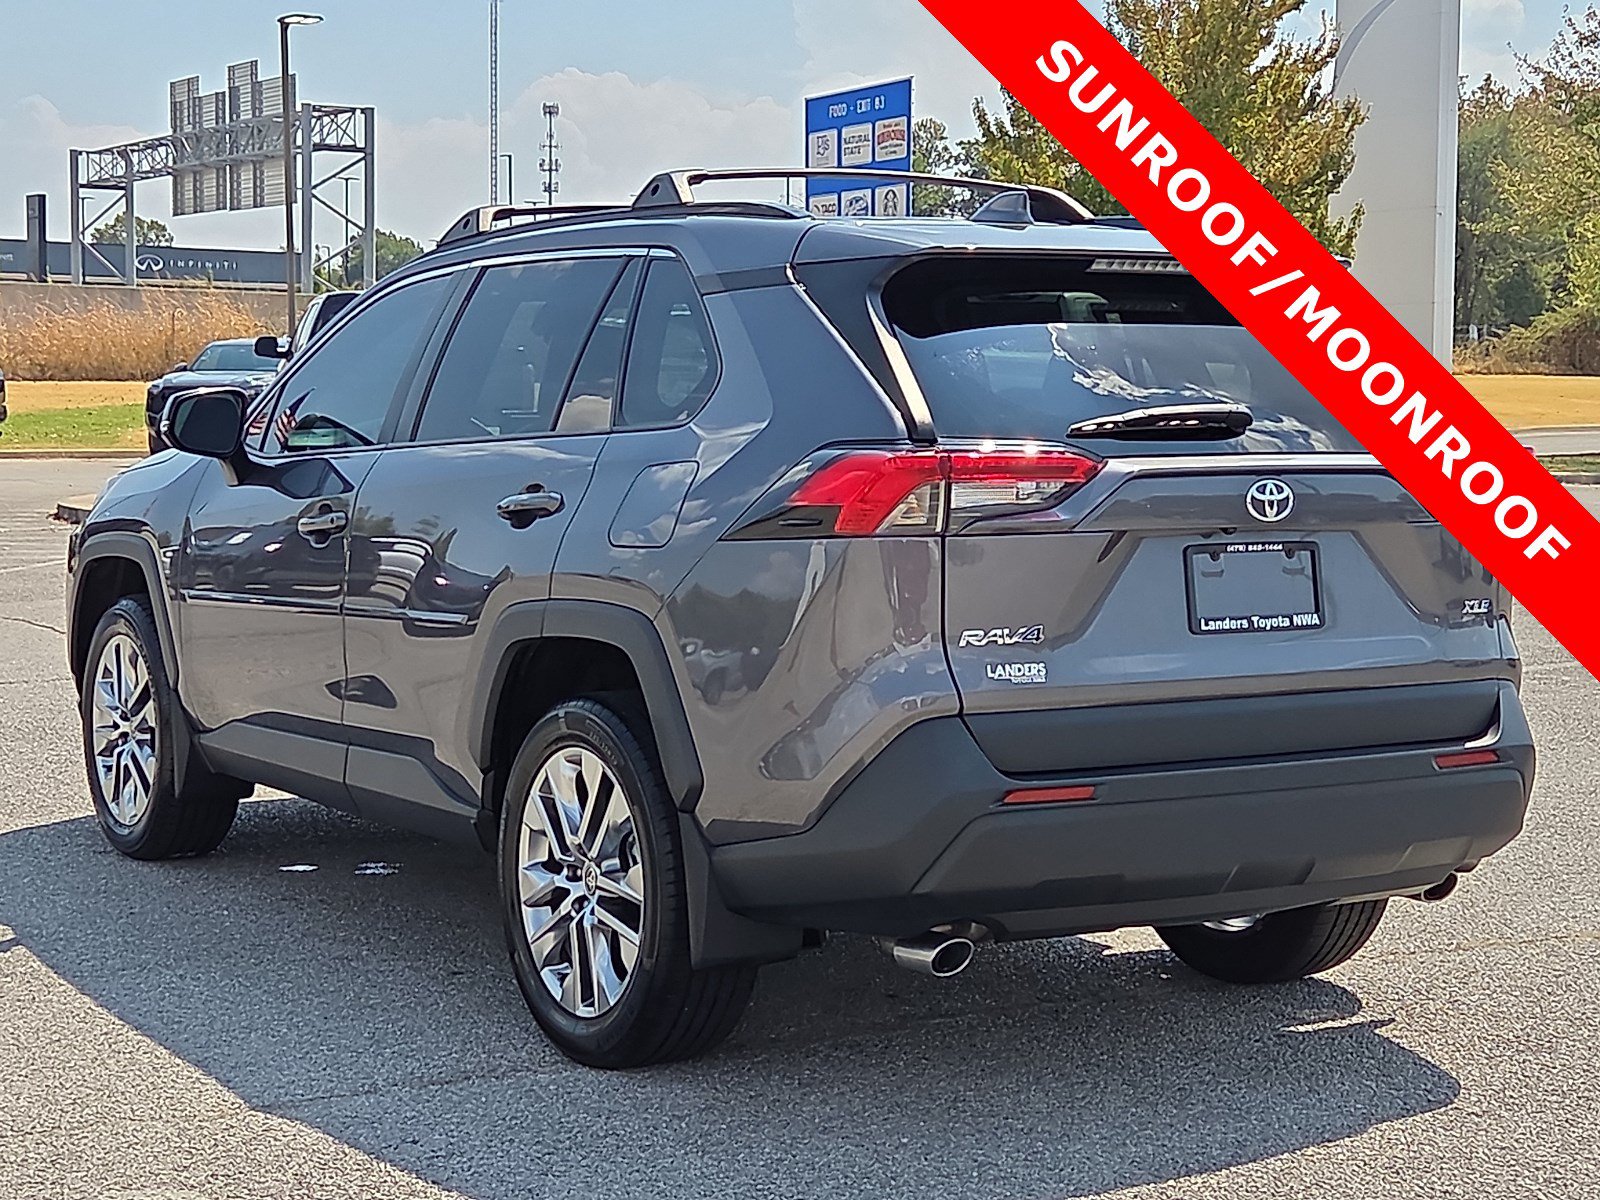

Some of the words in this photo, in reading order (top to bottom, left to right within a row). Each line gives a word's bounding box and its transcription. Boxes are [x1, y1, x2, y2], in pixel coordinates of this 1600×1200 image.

[828, 103, 848, 118] FOOD
[856, 98, 872, 114] EXIT
[843, 133, 871, 146] NATURAL
[843, 146, 862, 157] STATE
[169, 259, 238, 271] INFINITI
[1461, 599, 1490, 614] XLE
[1200, 617, 1249, 631] Landers
[1251, 615, 1291, 631] Toyota
[1292, 613, 1321, 627] NWA
[958, 624, 1045, 648] RAV4
[986, 662, 1047, 680] LANDERS
